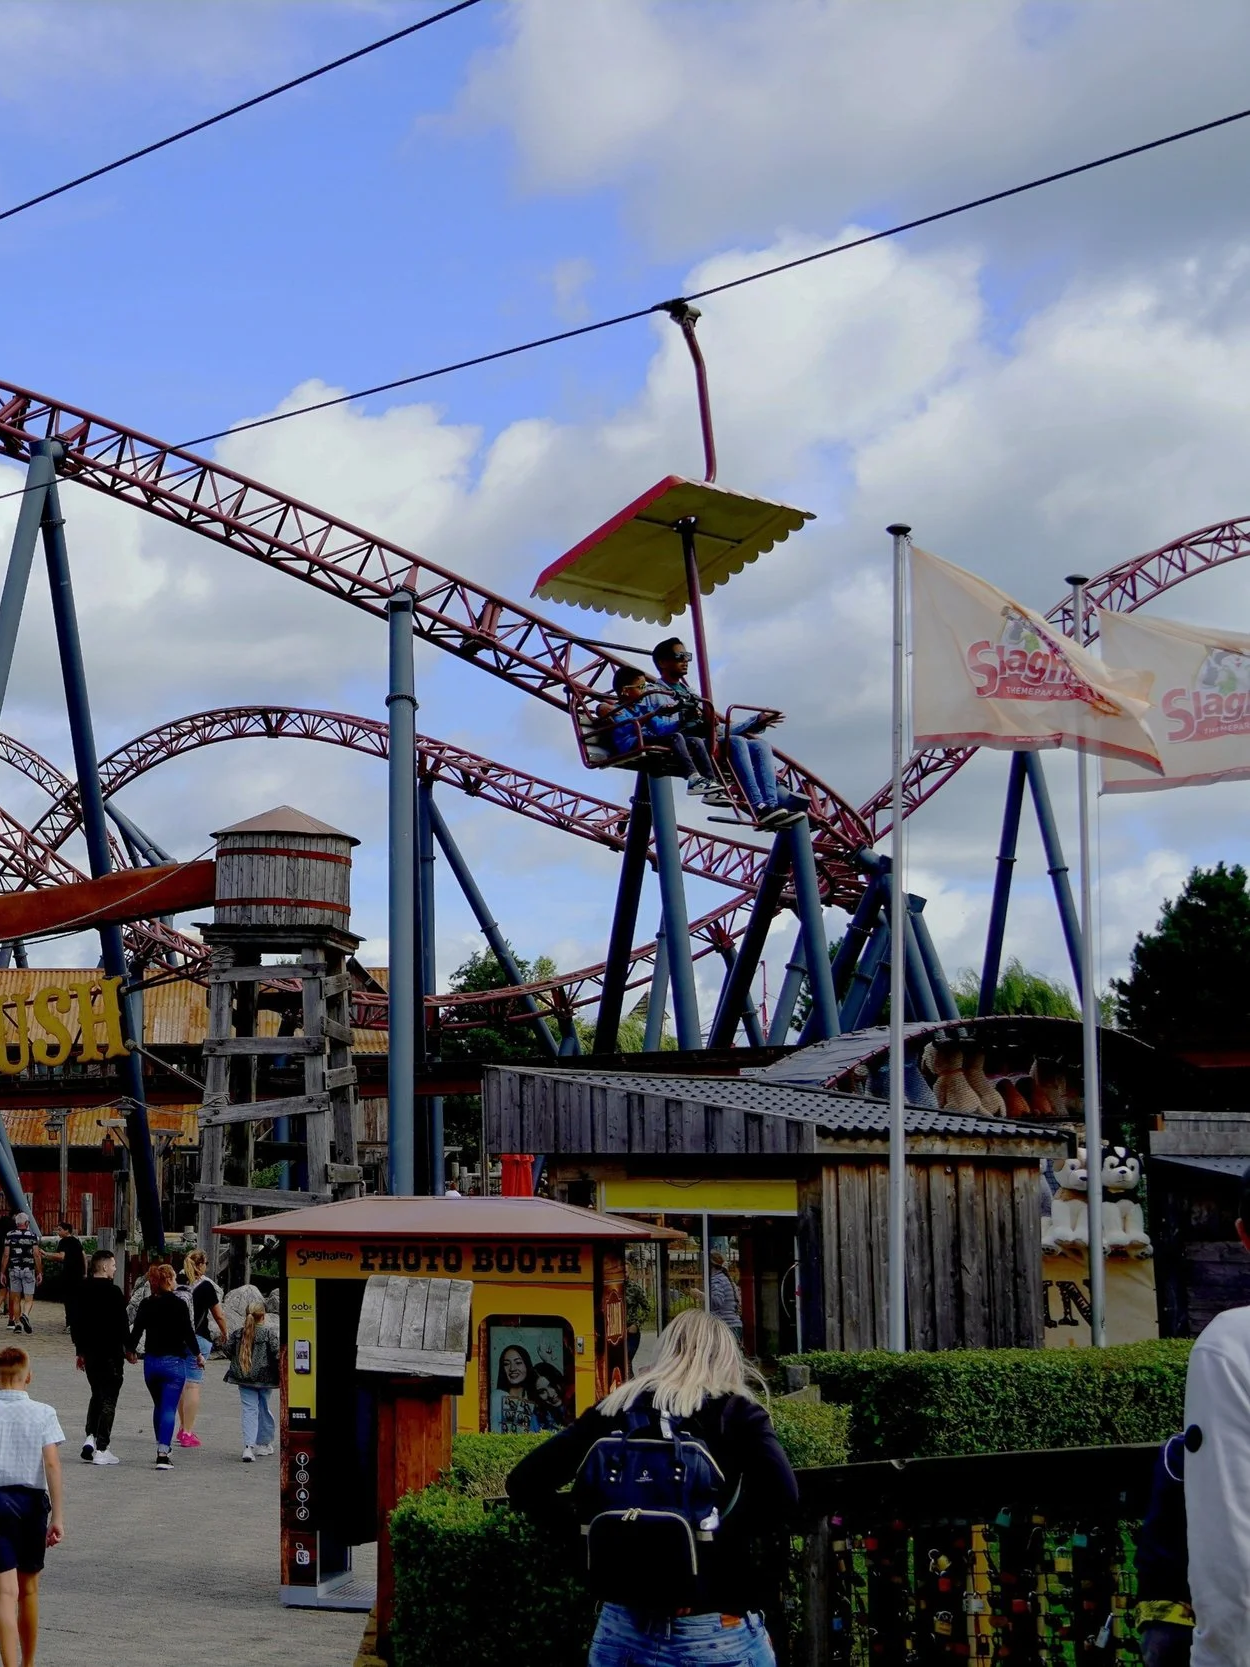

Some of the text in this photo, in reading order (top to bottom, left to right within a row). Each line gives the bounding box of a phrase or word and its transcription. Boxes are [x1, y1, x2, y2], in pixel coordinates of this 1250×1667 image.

[296, 1245, 582, 1274] Slagharen PHOTO BOOTH
